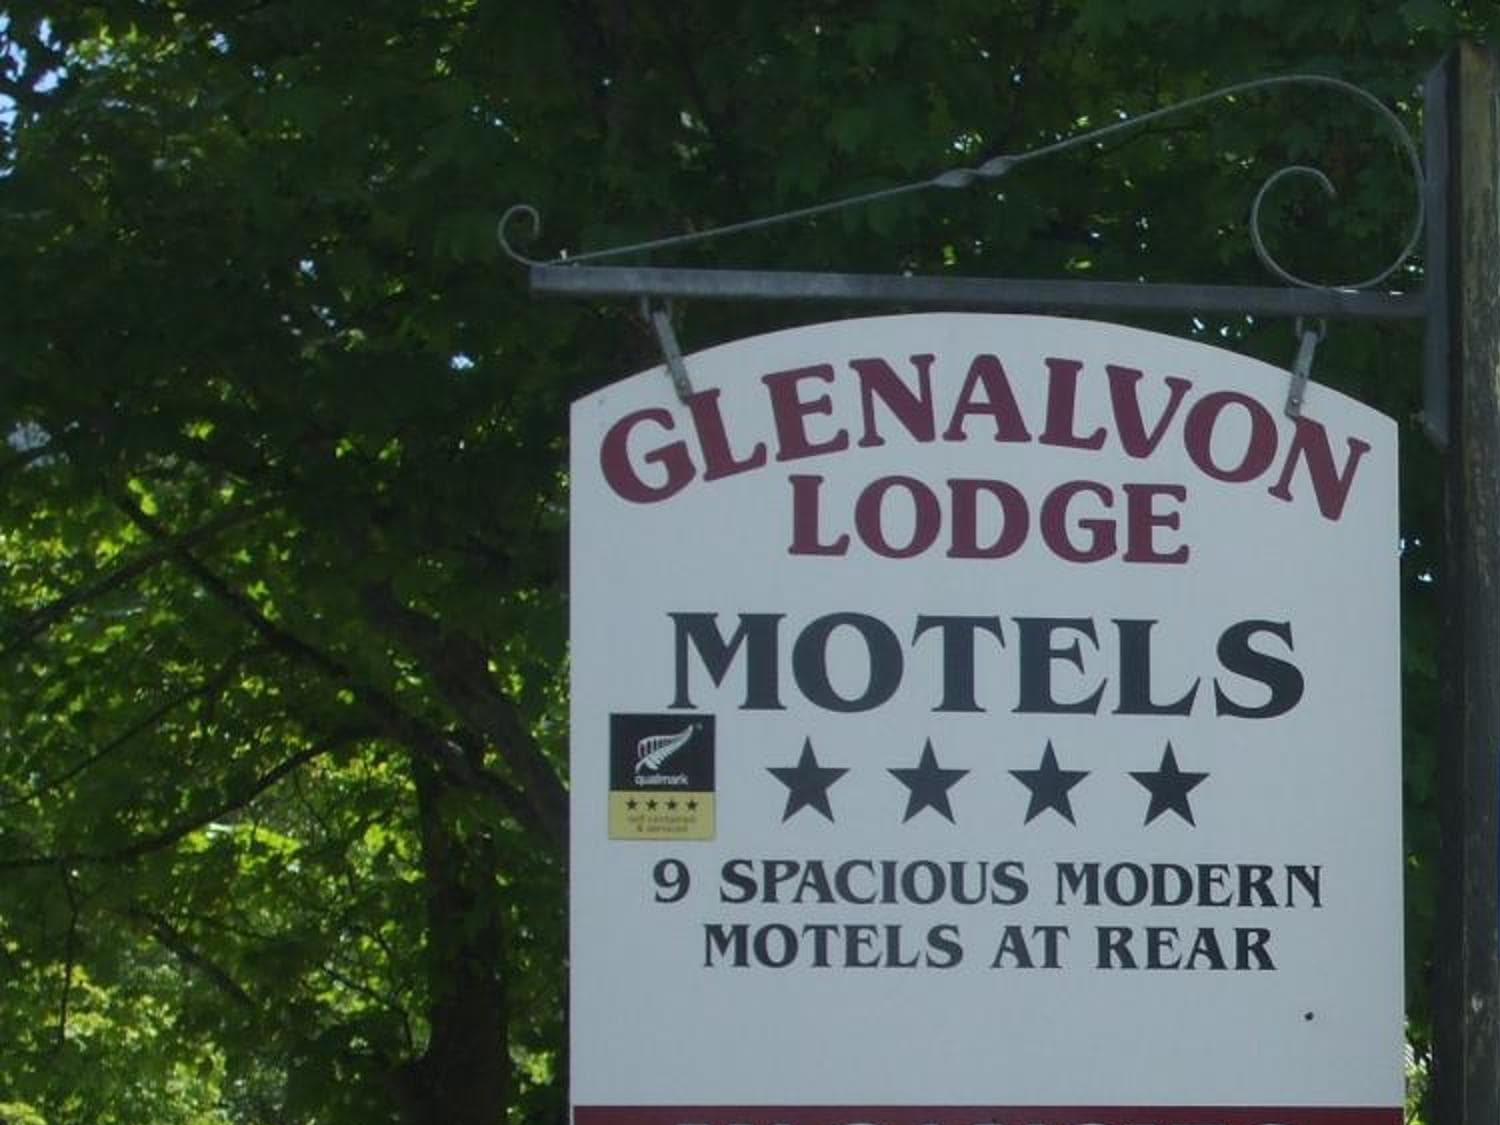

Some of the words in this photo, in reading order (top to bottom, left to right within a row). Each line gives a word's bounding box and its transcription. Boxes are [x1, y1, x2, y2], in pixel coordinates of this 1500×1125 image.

[600, 354, 1371, 522] GLENALVON
[788, 475, 1190, 565] LODGE
[666, 611, 1305, 719] MOTELS
[652, 858, 691, 904] 9
[719, 858, 1029, 906] SPACIOUS
[1055, 861, 1323, 908] MODERN
[703, 923, 964, 969] MOTELS
[991, 925, 1070, 969] AT
[1095, 925, 1277, 971] REAR
